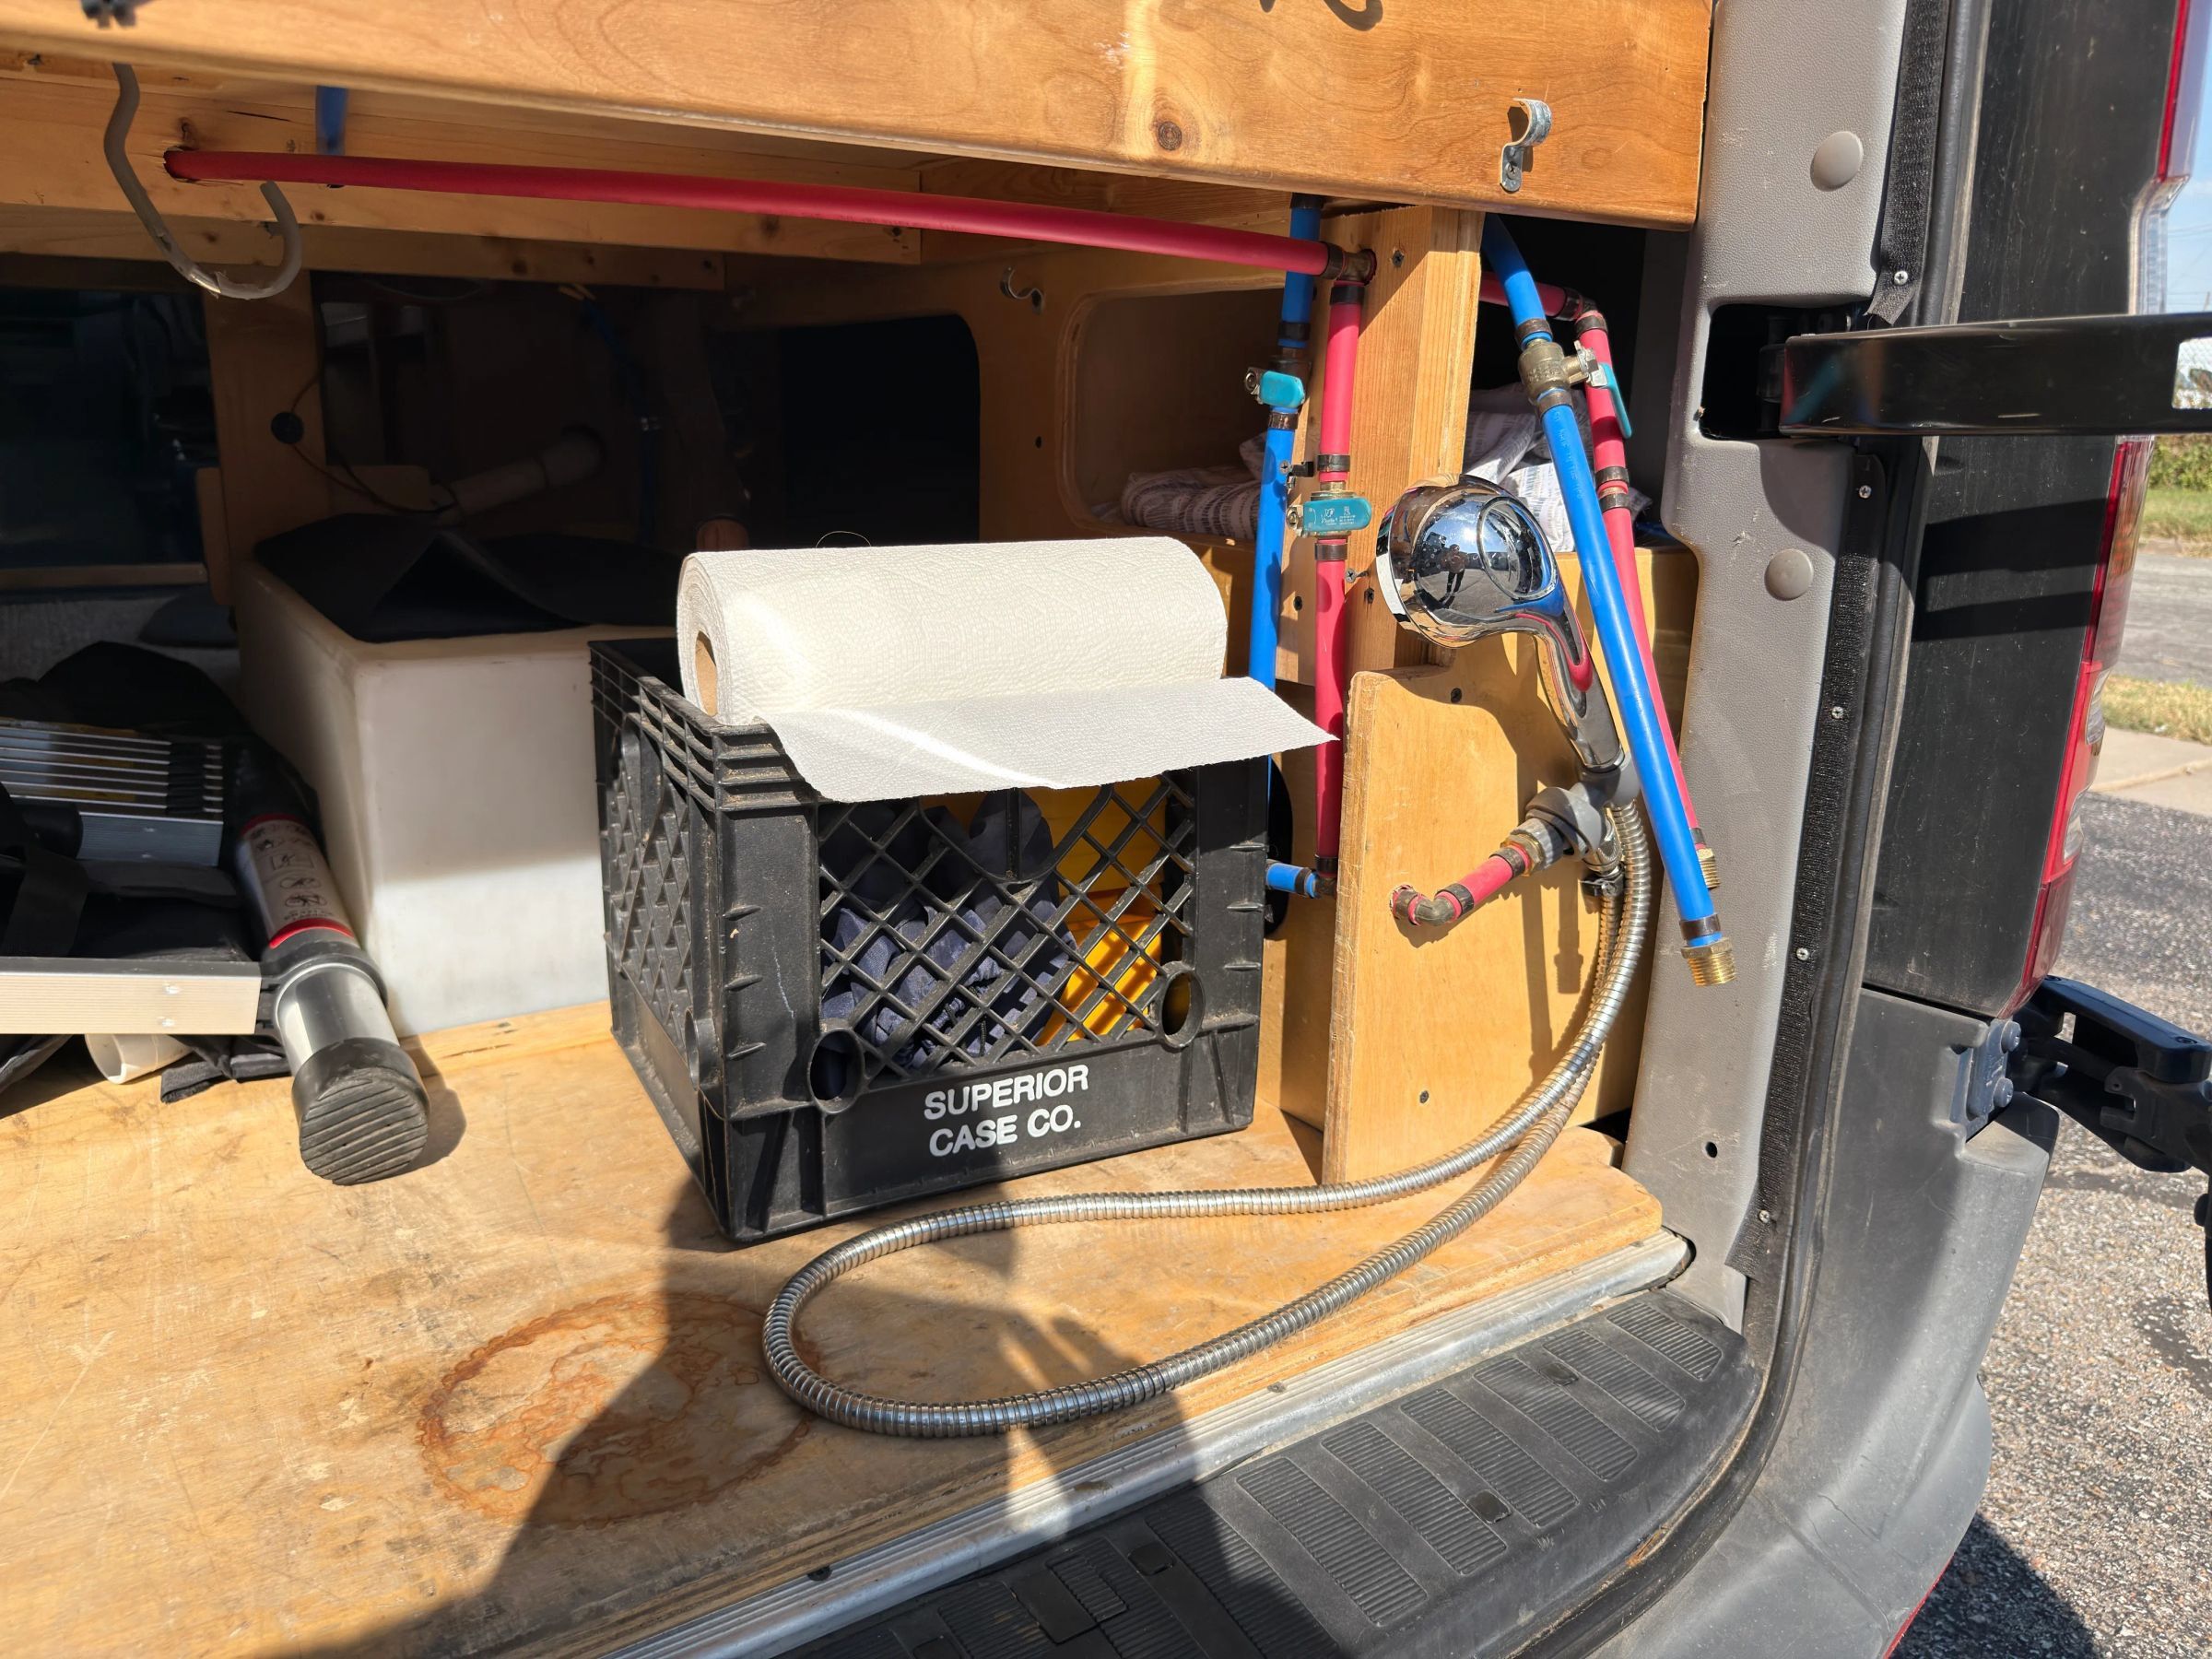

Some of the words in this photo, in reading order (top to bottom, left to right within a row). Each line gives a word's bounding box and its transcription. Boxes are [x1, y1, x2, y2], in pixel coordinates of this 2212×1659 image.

[924, 1065, 1088, 1120] SUPERIOR
[929, 1114, 1018, 1157] CASE
[1027, 1104, 1081, 1138] CO.
